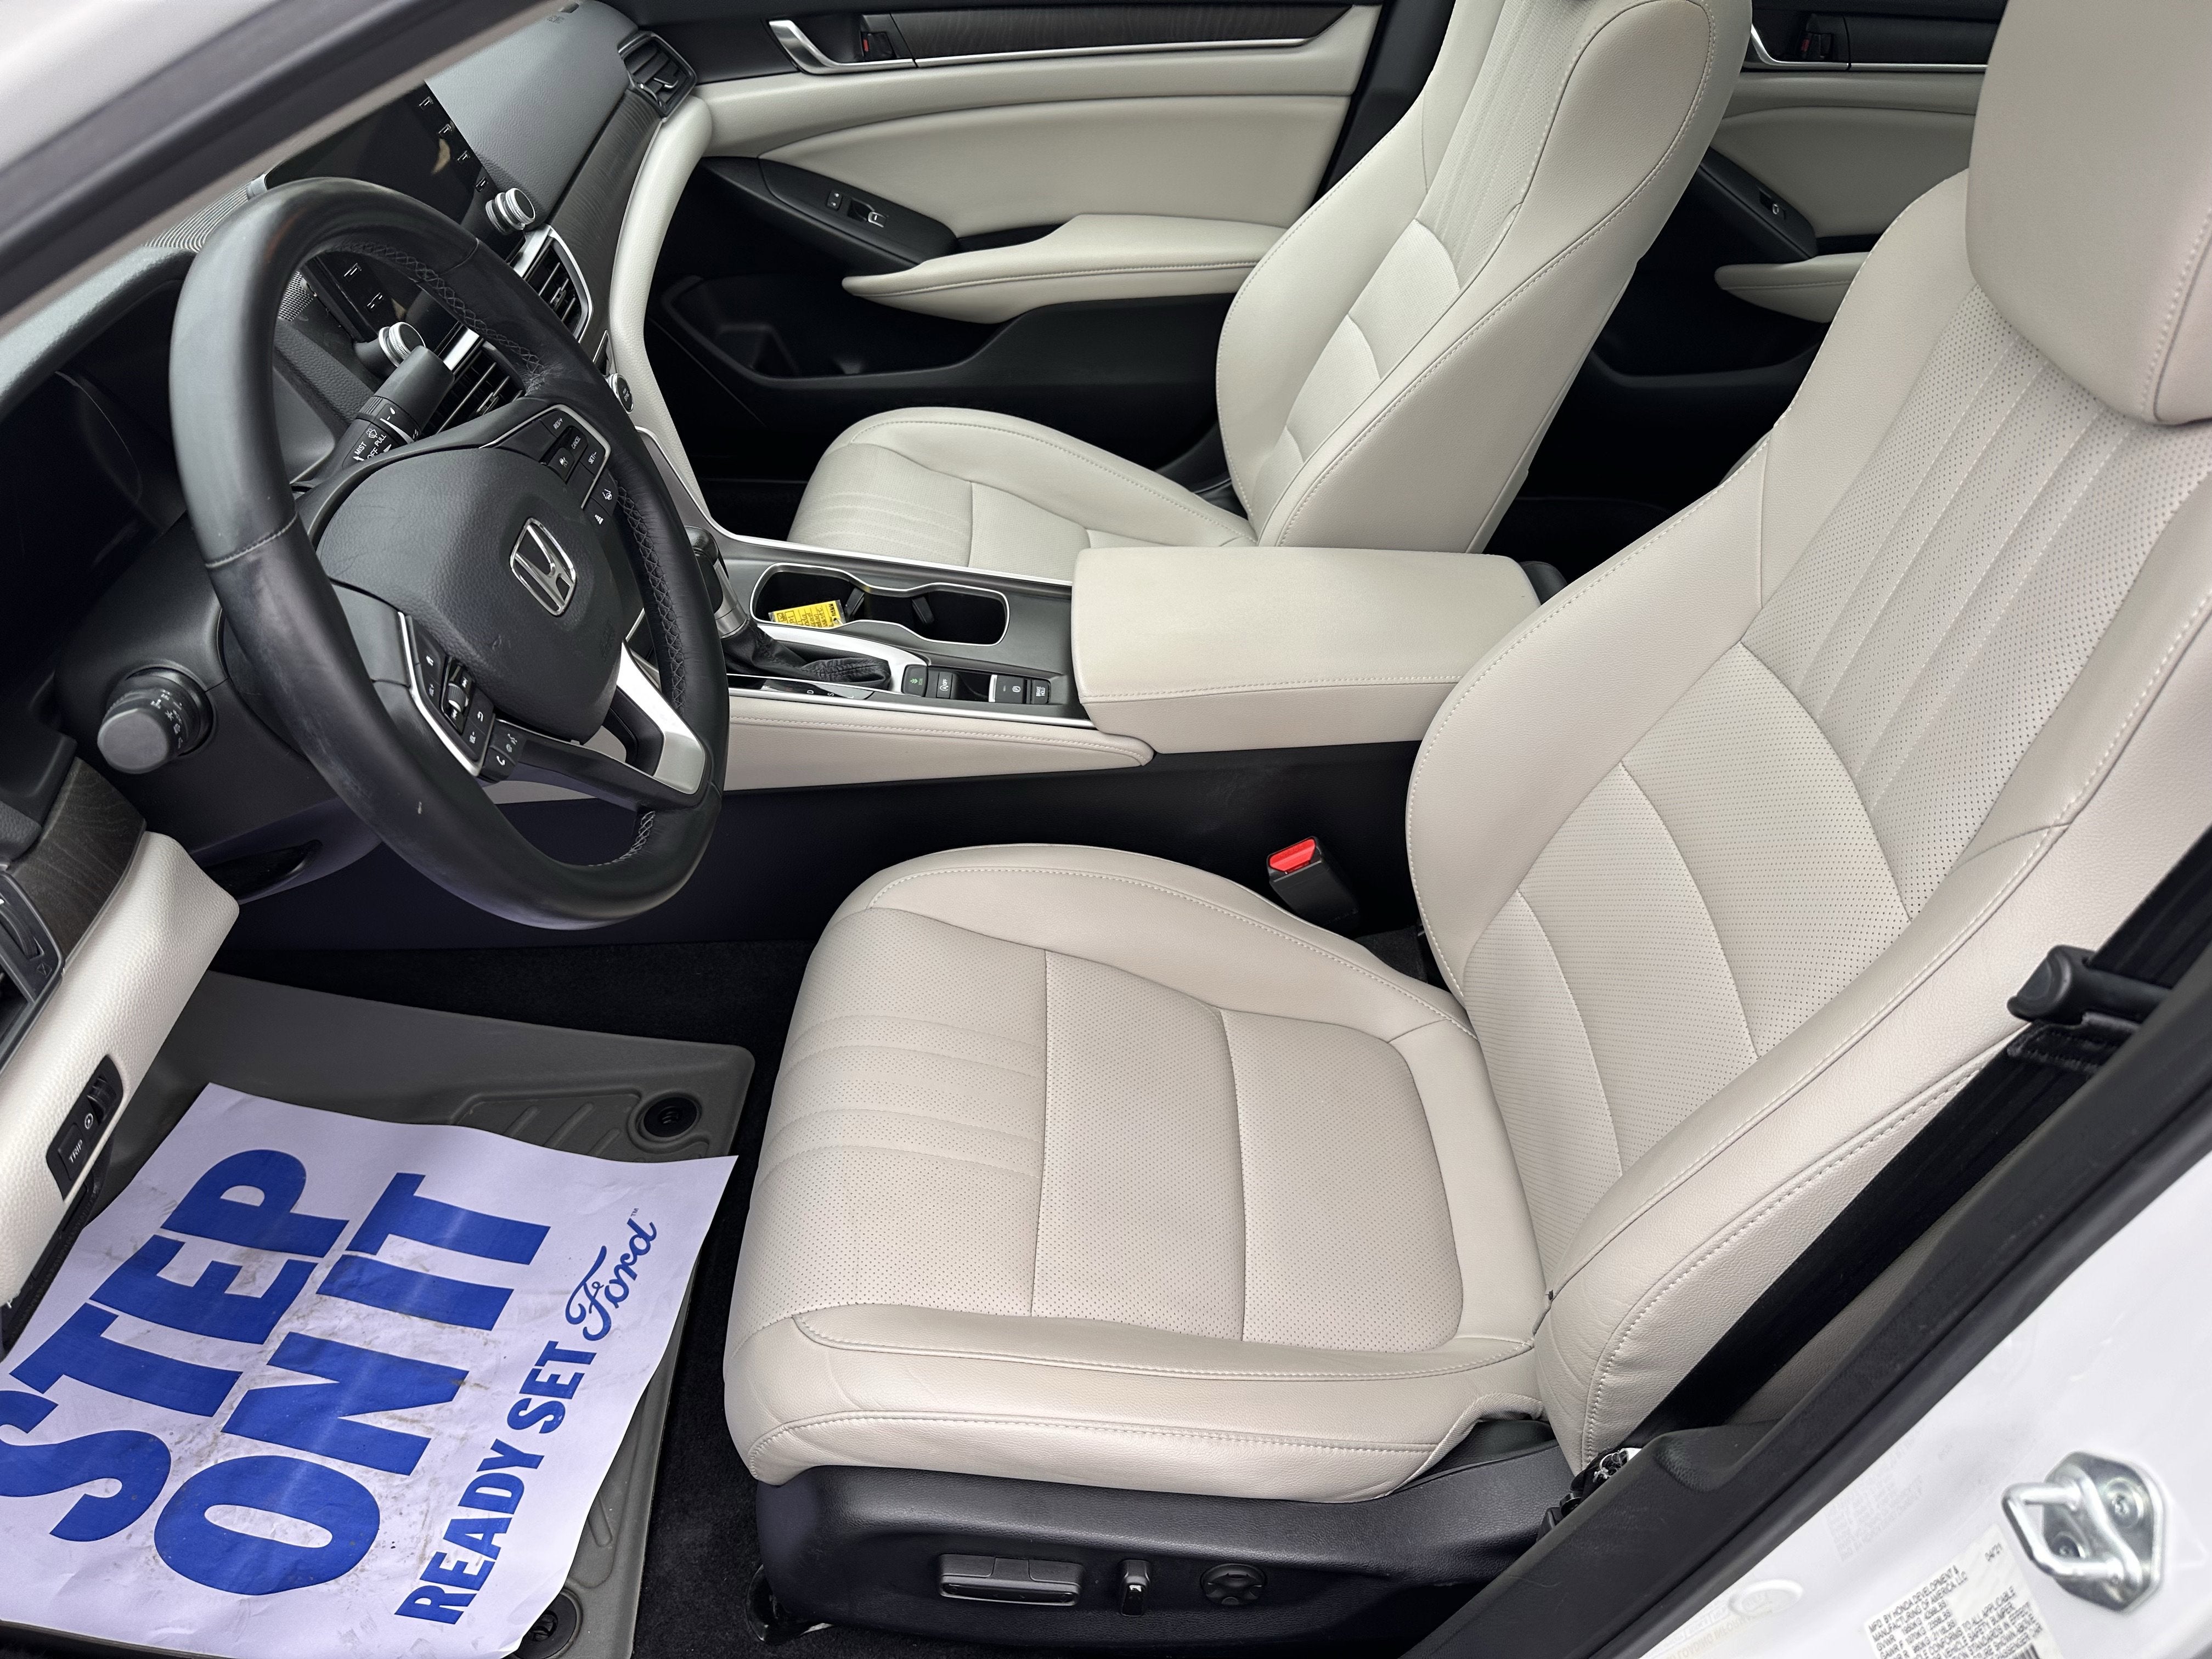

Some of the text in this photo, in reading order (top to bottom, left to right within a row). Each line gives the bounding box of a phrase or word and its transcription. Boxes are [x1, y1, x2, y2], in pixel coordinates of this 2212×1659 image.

[354, 442, 367, 455] MIST
[374, 435, 386, 447] PULL
[367, 447, 379, 459] OFF
[69, 1139, 83, 1163] TRIP
[0, 1149, 349, 1542] STEP
[154, 1172, 551, 1596] ON IT
[394, 1438, 545, 1625] READY
[506, 1340, 597, 1434] SET
[565, 1218, 657, 1341] Ford
[1891, 1598, 1914, 1617] HONDA
